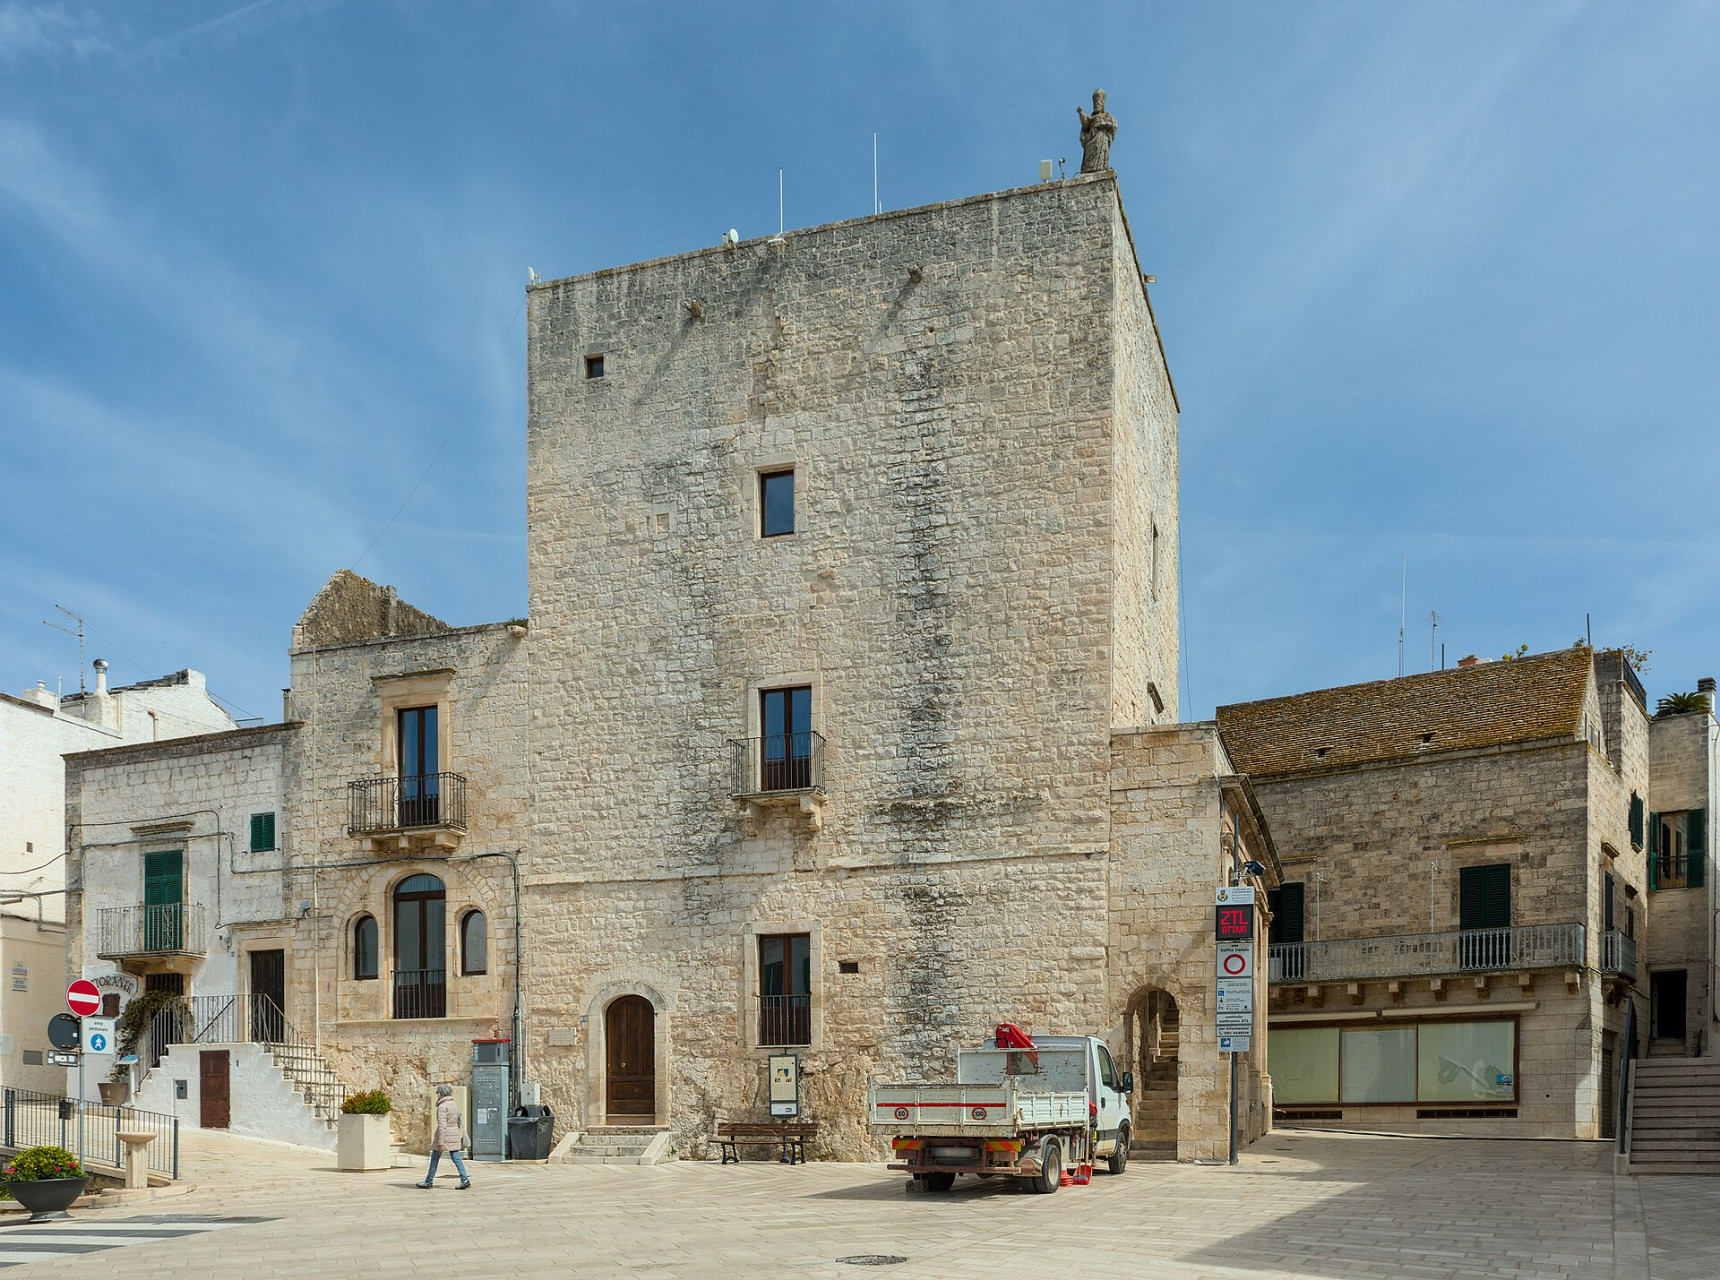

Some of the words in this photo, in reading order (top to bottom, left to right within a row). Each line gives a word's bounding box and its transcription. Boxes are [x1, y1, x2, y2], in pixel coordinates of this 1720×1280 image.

[1221, 910, 1248, 925] ZTL
[1222, 925, 1248, 934] ATTIVA
[91, 975, 134, 995] TORANTE
